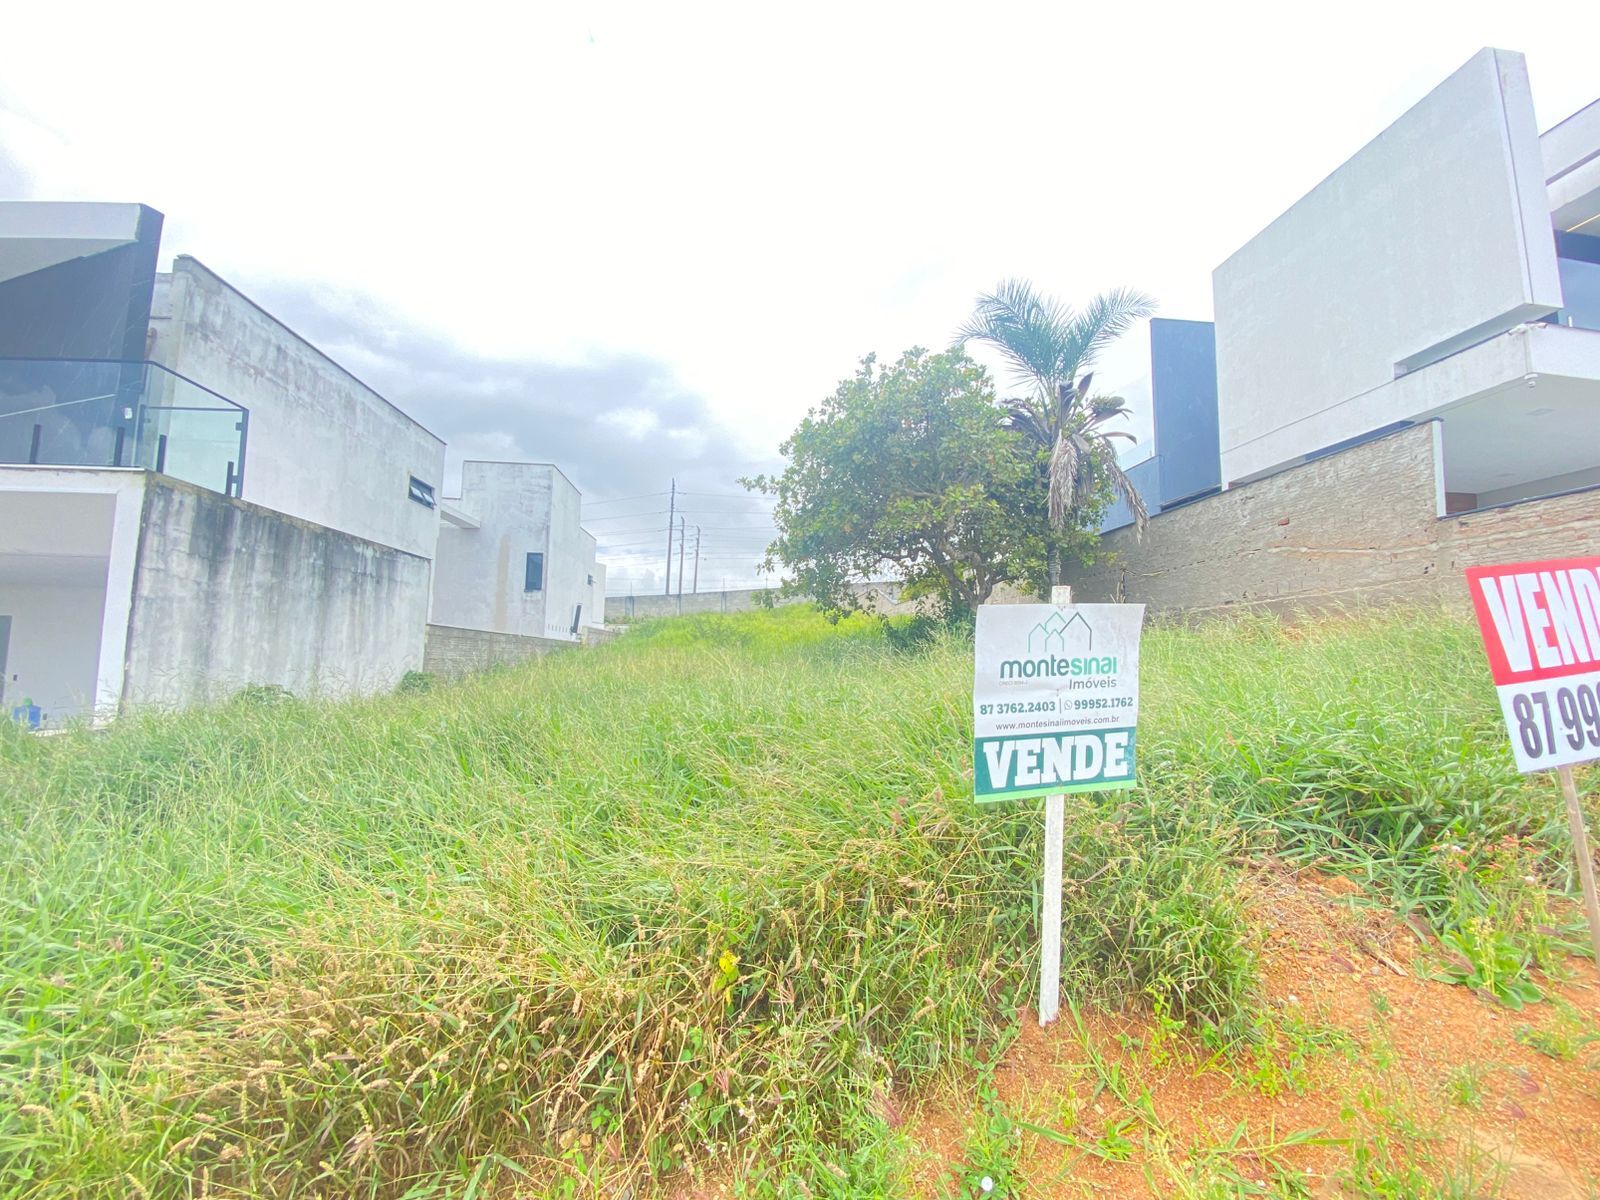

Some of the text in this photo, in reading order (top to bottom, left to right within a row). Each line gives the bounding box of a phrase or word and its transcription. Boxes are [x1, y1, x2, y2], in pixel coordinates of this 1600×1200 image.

[1478, 566, 1600, 673] VEND
[1000, 654, 1117, 678] montesinai
[1069, 676, 1117, 690] Imóveis
[980, 697, 1134, 715] 87 3762.2403 99952.1762
[996, 715, 1120, 731] www.montesinaiimoveis.com.br
[1512, 680, 1600, 759] 87 99
[983, 731, 1129, 789] VENDE
